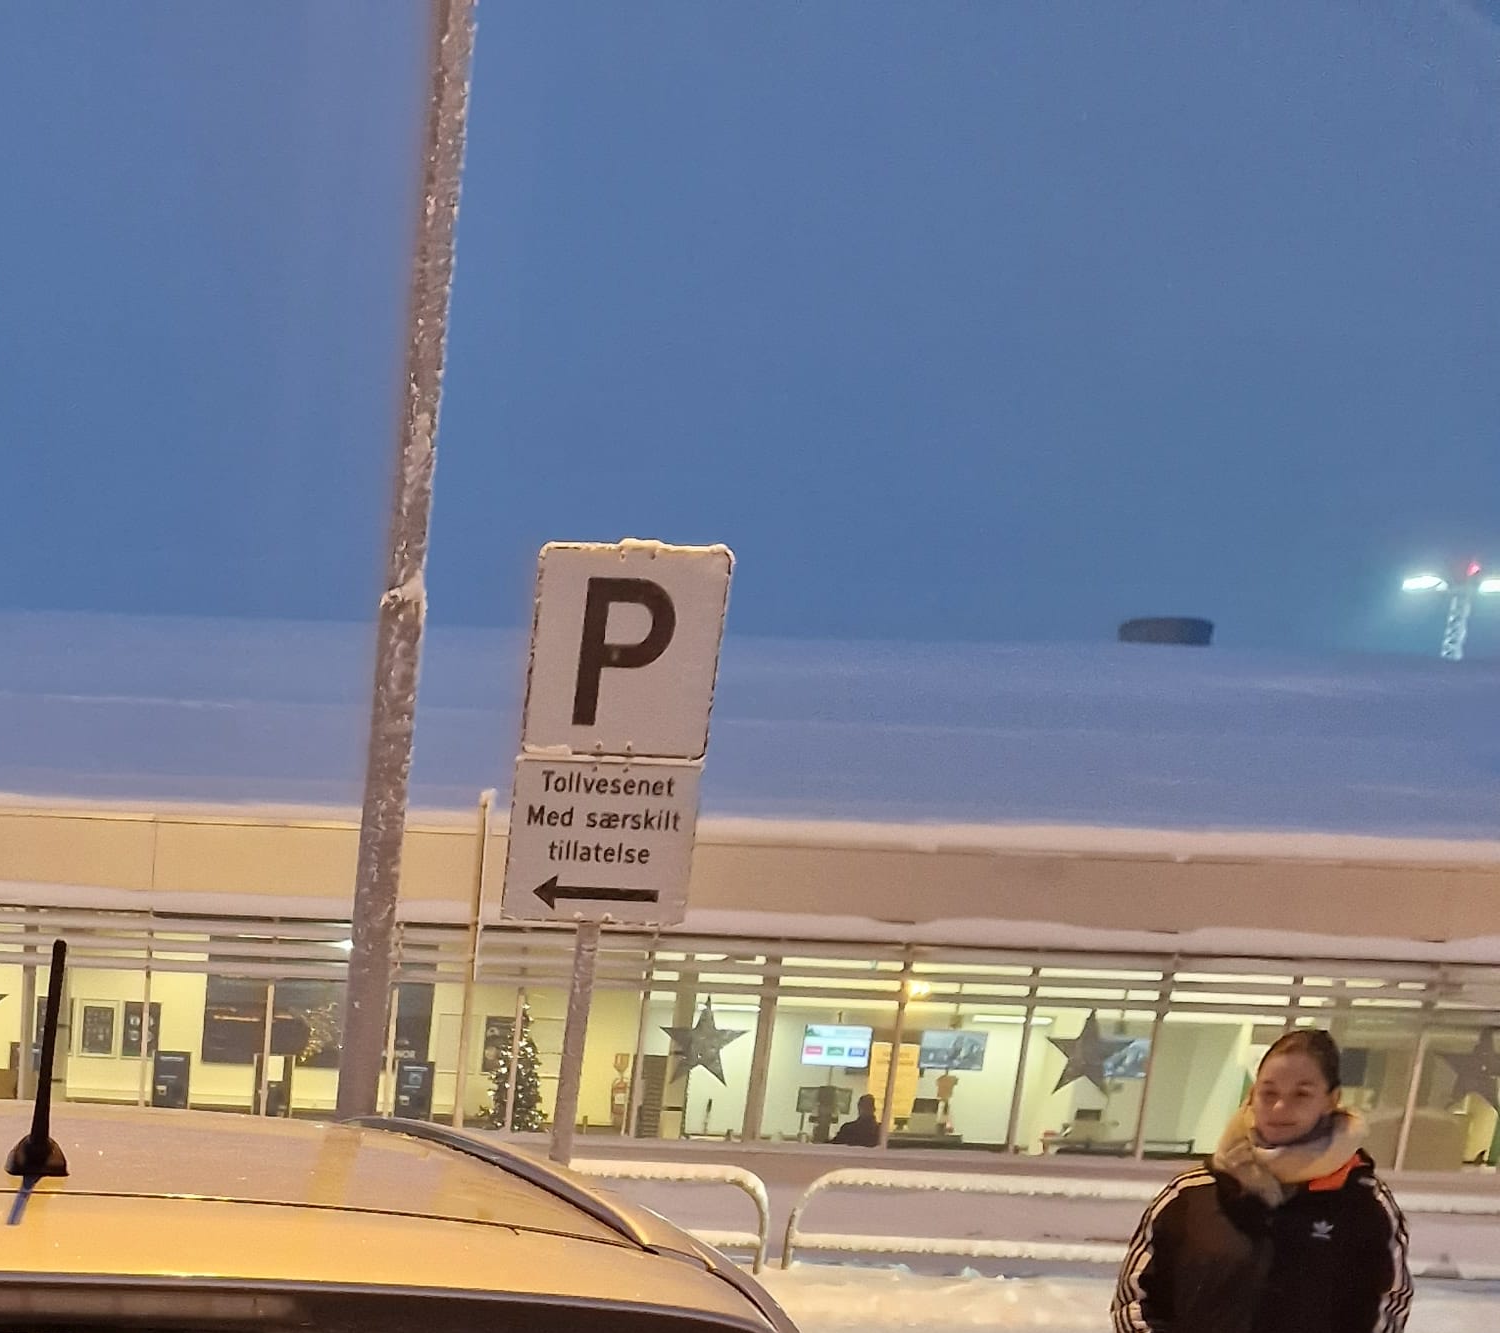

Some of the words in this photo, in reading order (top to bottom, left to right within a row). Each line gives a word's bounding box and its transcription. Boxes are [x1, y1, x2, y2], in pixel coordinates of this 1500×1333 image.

[572, 577, 677, 726] P
[542, 770, 676, 797] Tollvesenet
[527, 804, 574, 827] Med
[586, 808, 681, 832] særskilt
[549, 840, 650, 864] tillatelse
